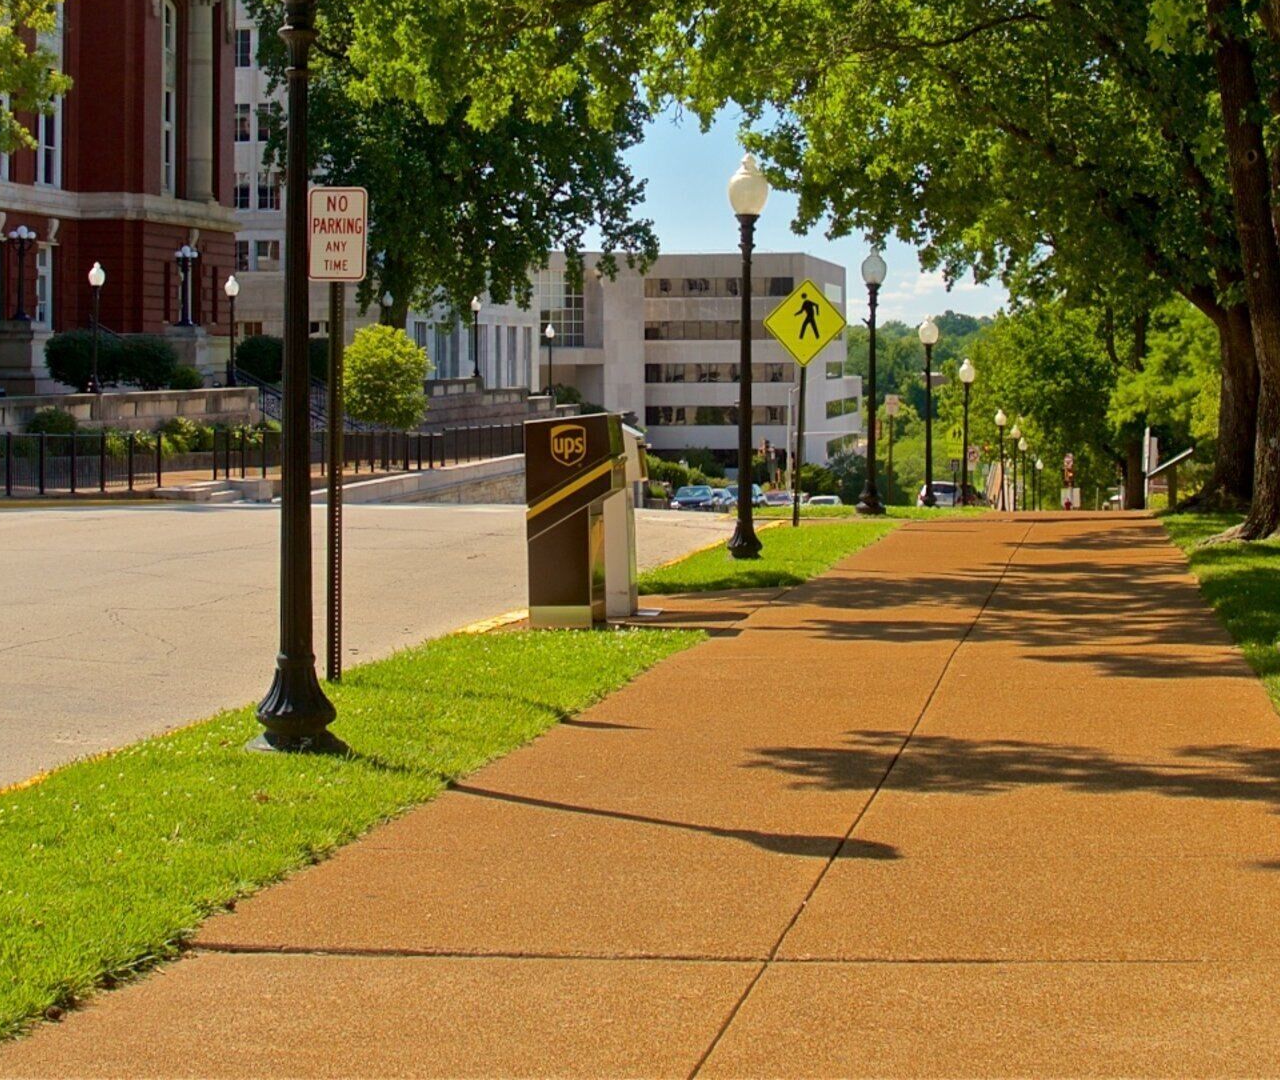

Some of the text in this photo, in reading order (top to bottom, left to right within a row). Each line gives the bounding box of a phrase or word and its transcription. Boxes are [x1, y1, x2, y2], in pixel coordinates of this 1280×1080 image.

[327, 196, 348, 212] NO
[313, 218, 362, 235] PARKING
[325, 241, 347, 253] ANY
[324, 259, 348, 272] TIME
[553, 437, 583, 460] ups
